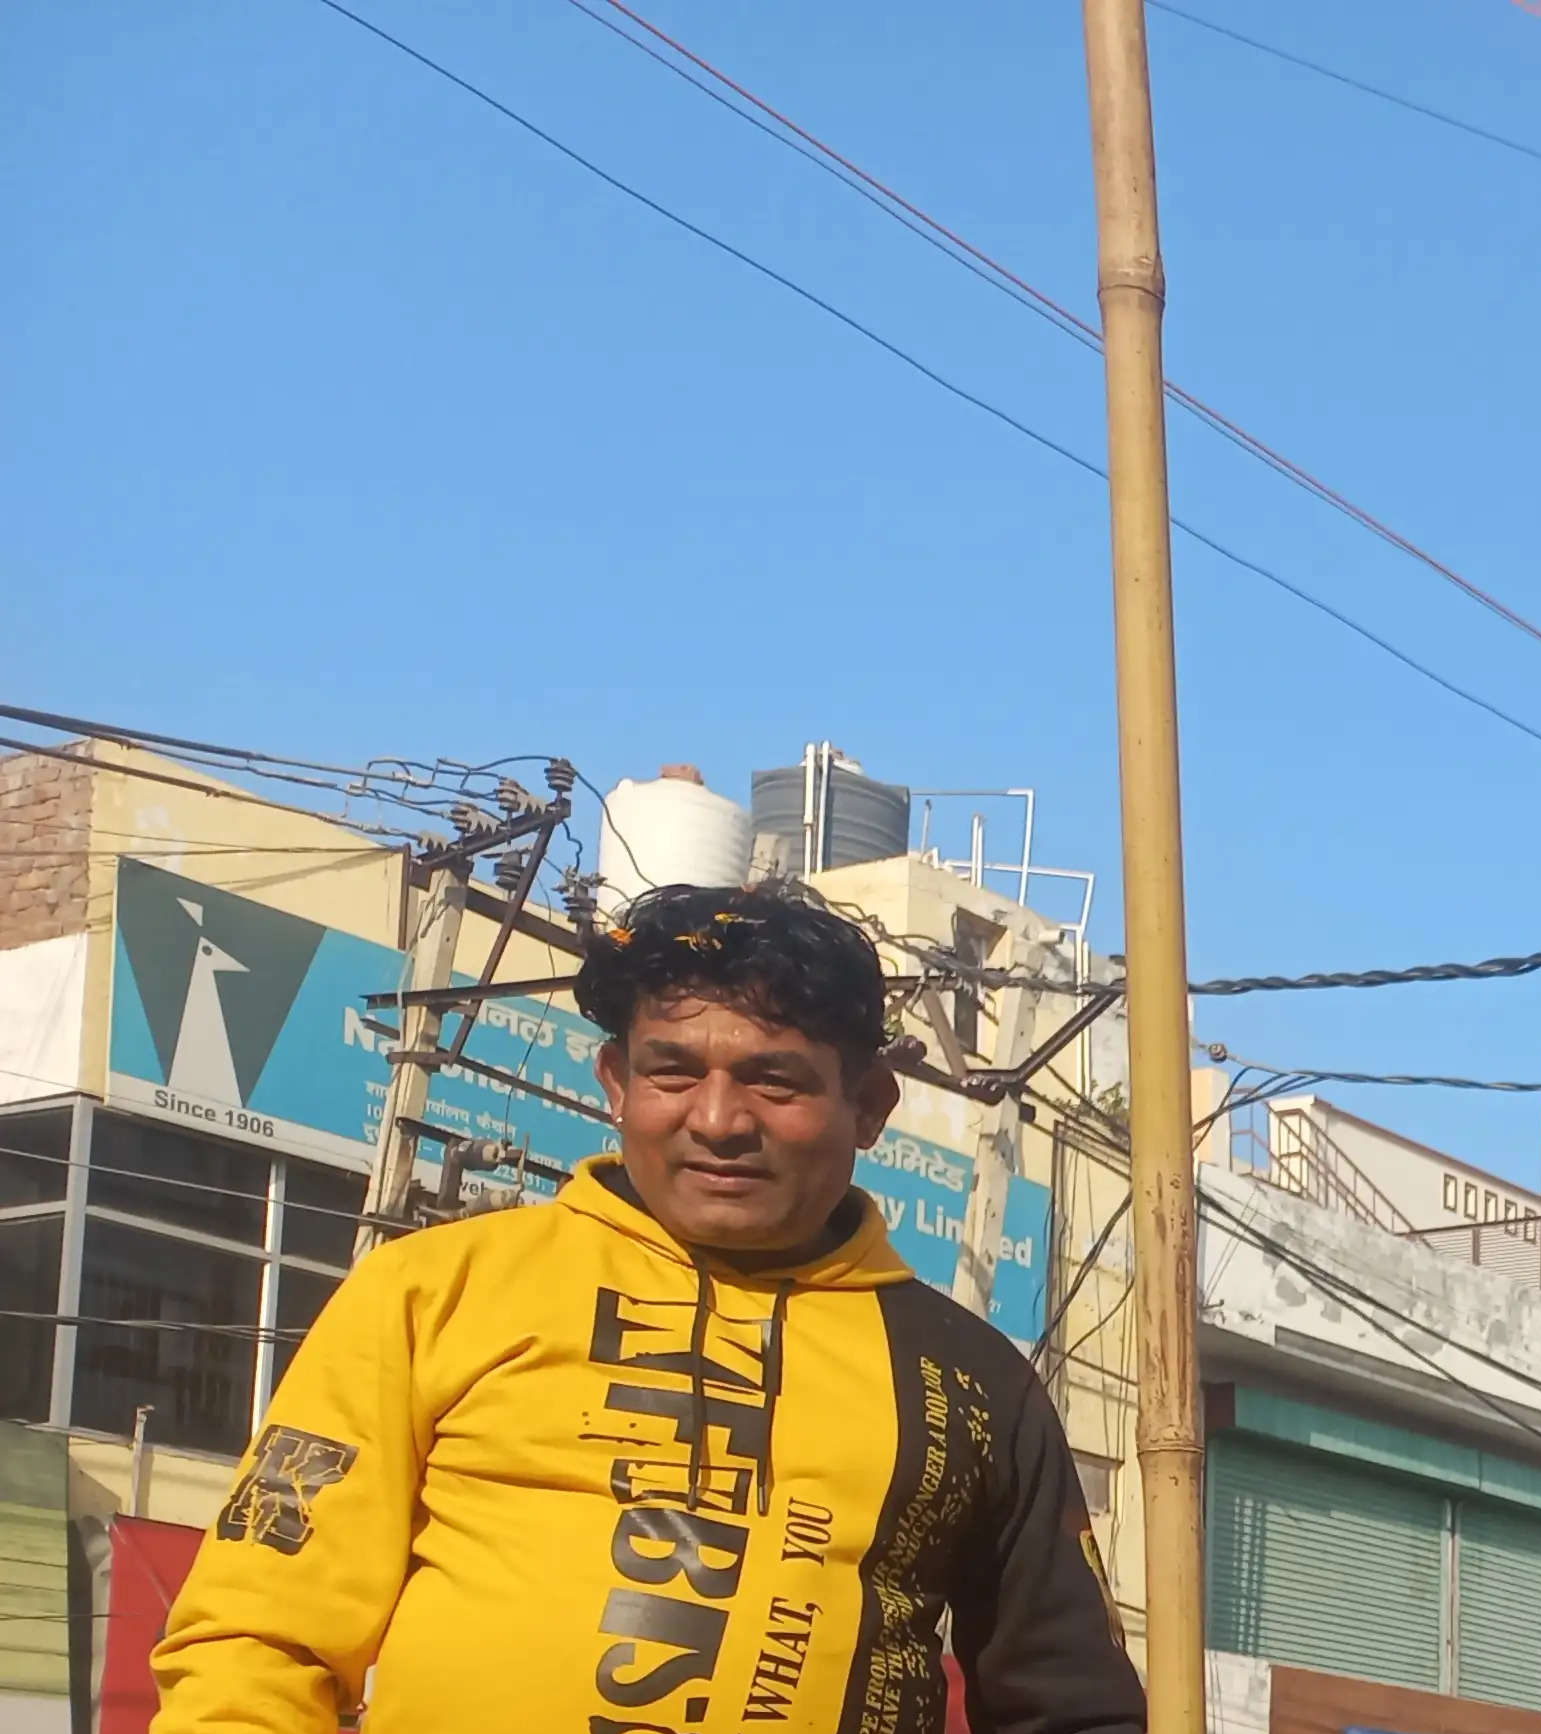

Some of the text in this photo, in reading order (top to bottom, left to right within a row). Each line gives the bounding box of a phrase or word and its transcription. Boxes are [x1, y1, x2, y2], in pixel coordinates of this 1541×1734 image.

[154, 1088, 275, 1138] Since 1906
[898, 1445, 947, 1531] LONGER
[781, 1496, 834, 1567] YOU
